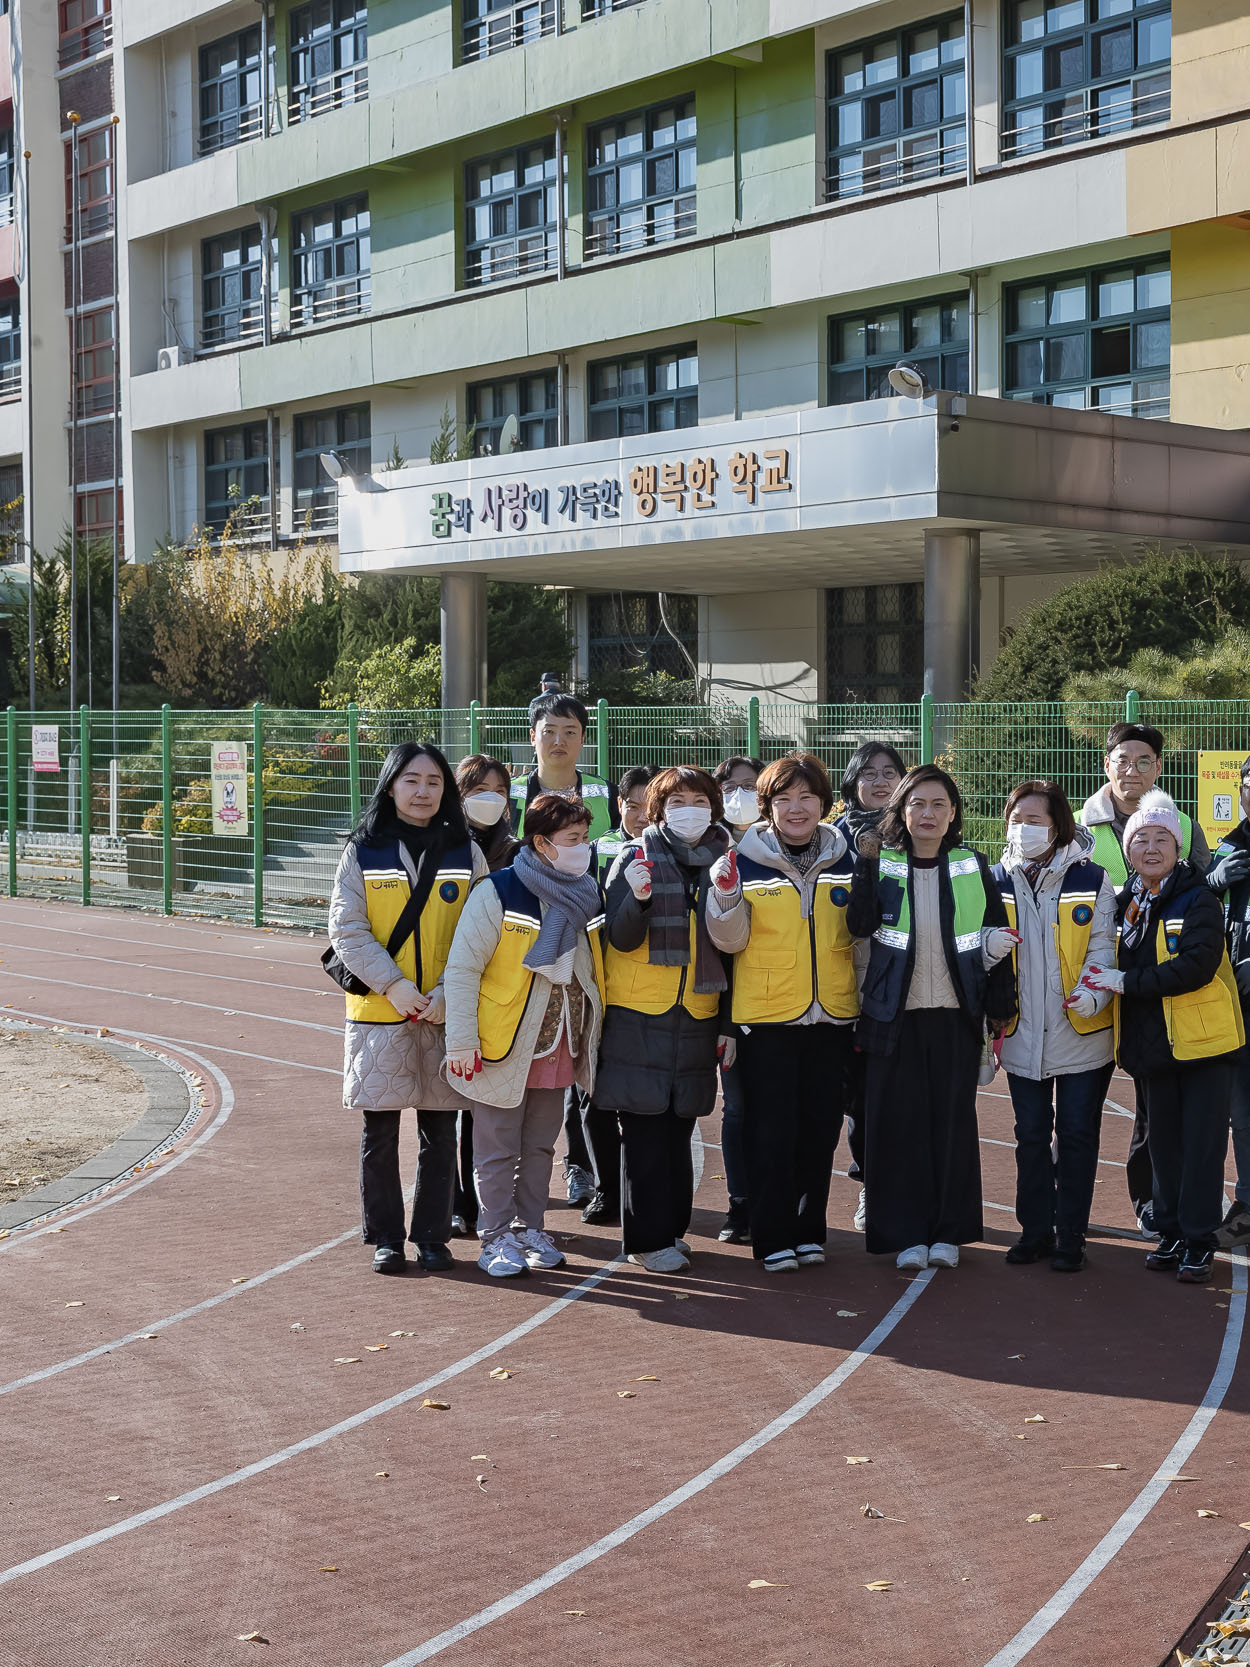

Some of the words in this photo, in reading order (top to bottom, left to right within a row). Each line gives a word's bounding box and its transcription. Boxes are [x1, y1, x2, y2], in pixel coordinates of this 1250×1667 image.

[430, 492, 473, 538] 꿈과
[479, 482, 549, 532] 사랑이
[557, 479, 622, 523] 가득한
[629, 457, 719, 517] 행복한
[728, 449, 792, 505] 학교
